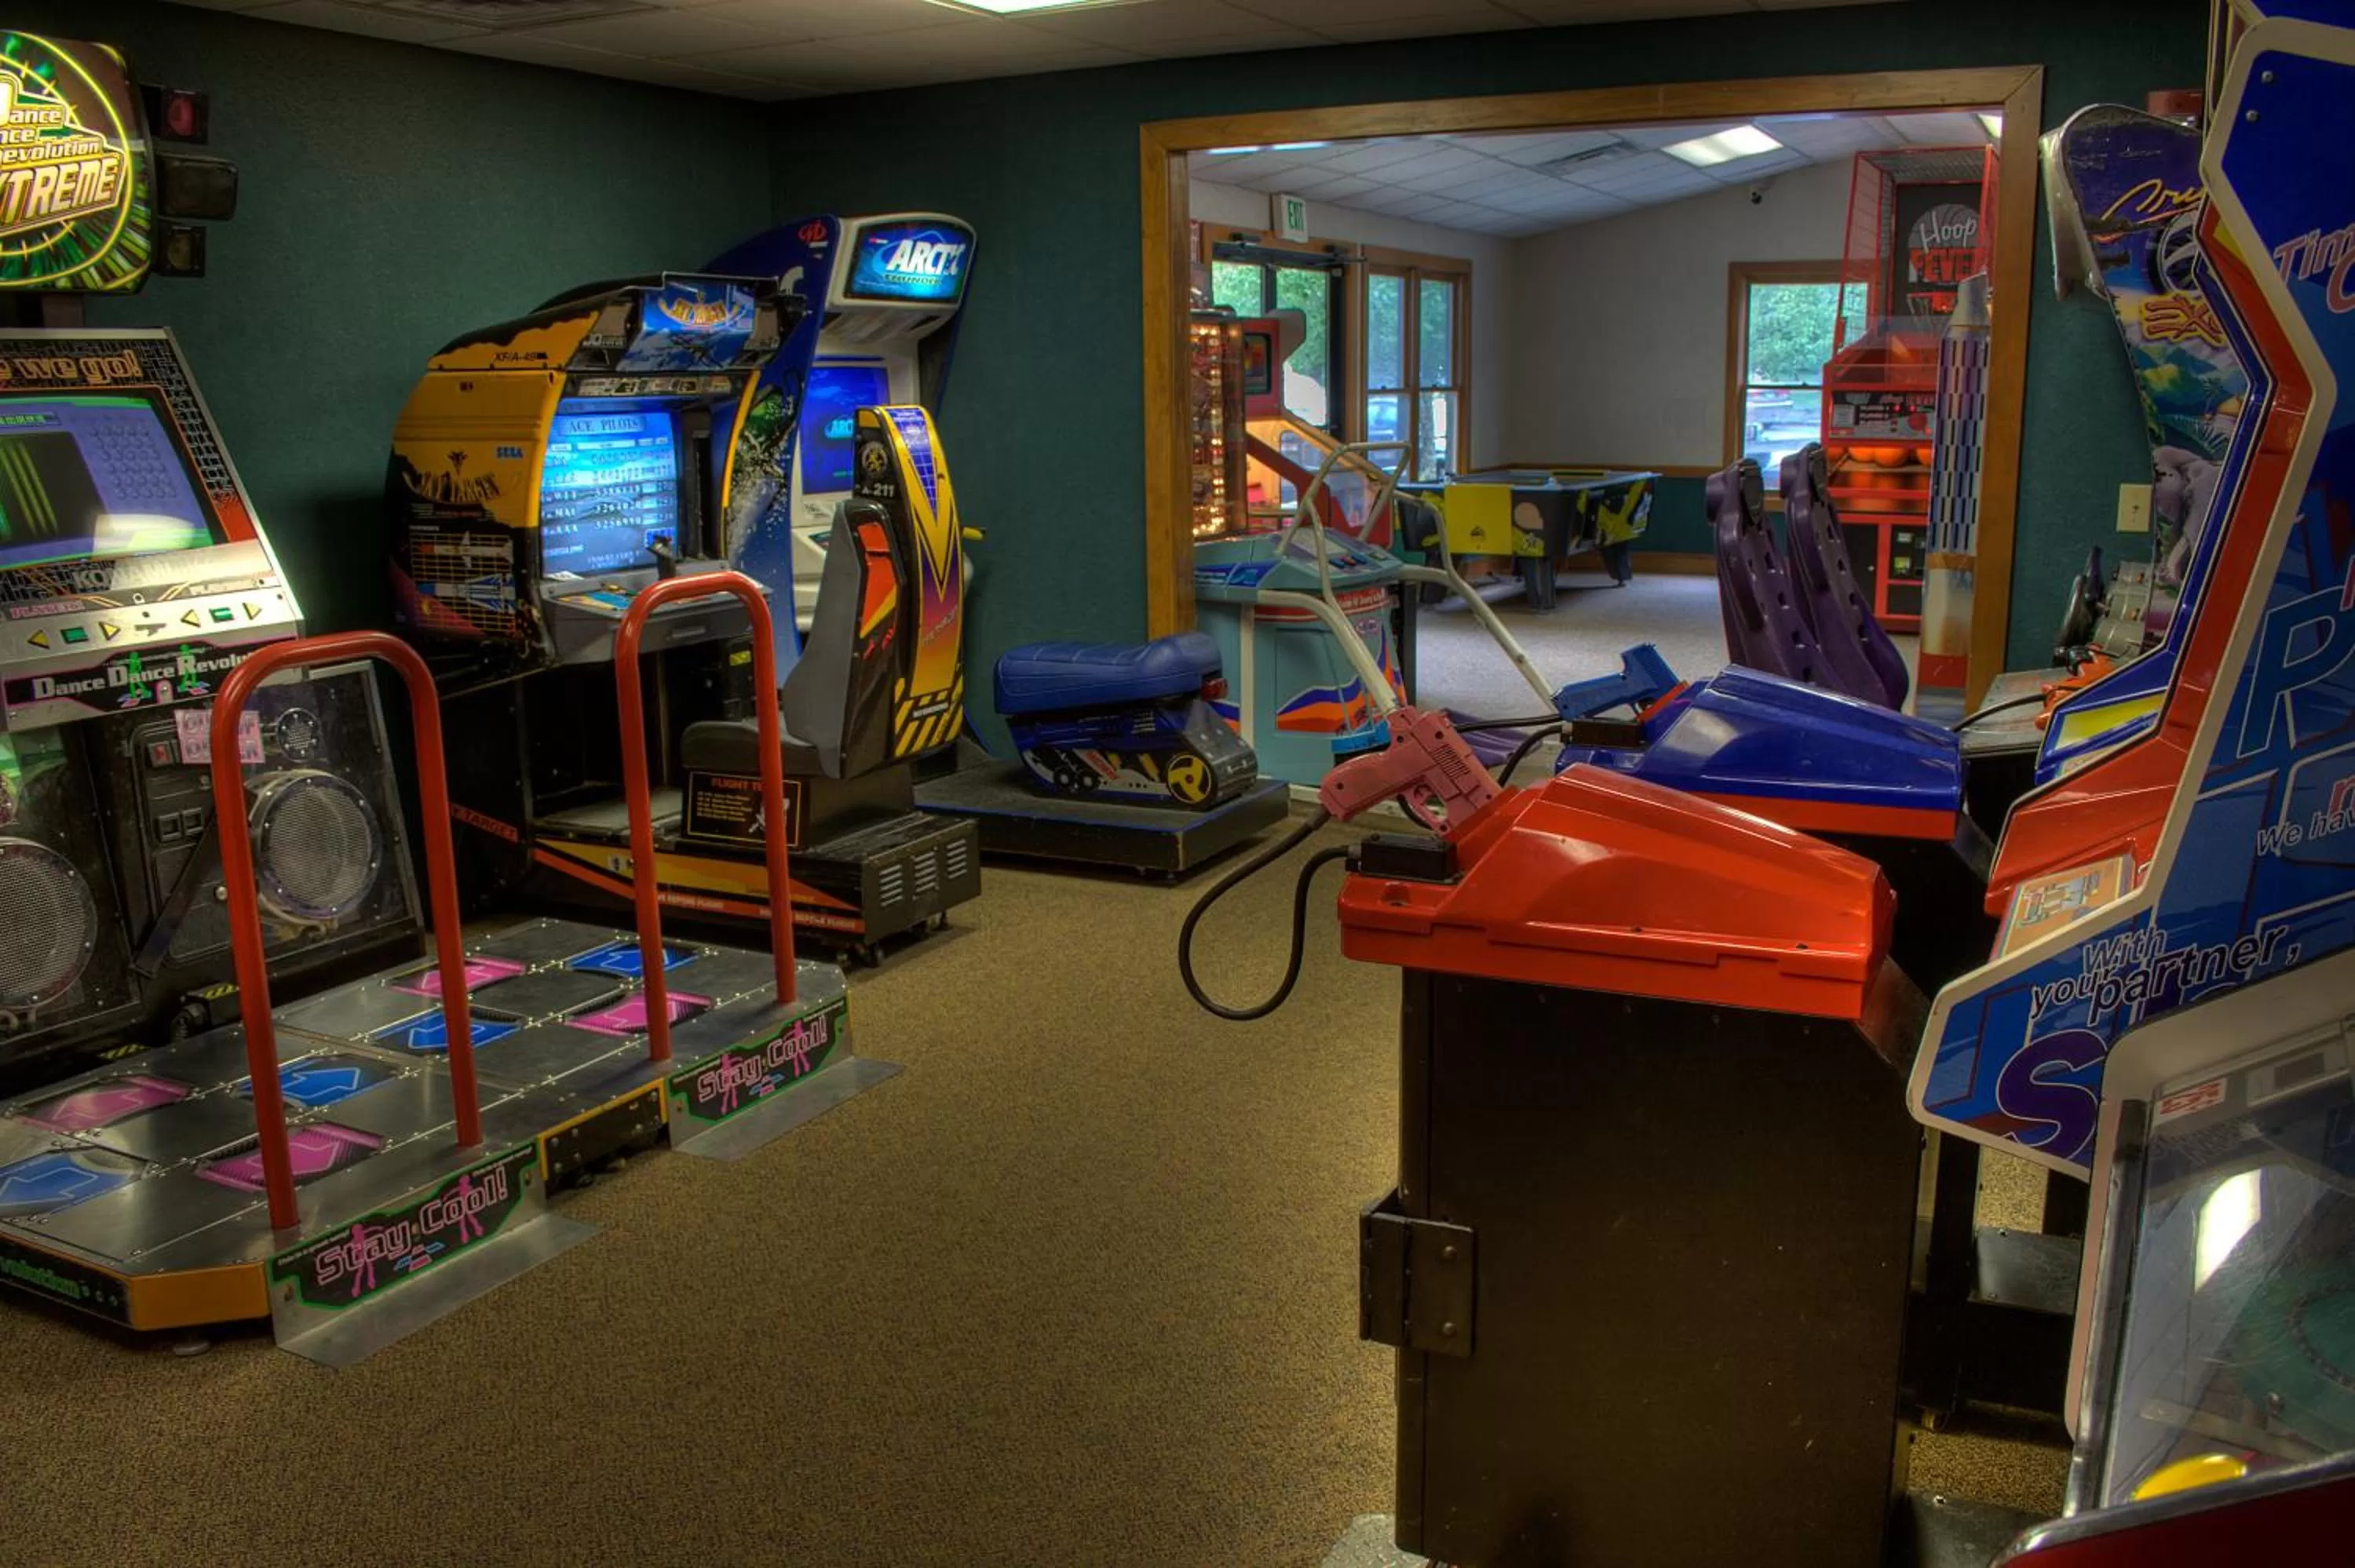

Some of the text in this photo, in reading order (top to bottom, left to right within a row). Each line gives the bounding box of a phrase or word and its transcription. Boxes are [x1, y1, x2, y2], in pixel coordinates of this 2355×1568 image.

[0, 127, 35, 144] nce
[0, 140, 99, 163] evolution
[0, 158, 118, 224] TREME
[1287, 200, 1304, 230] EXIT
[1919, 210, 1977, 254] Hoop
[2273, 223, 2355, 284] Tim
[79, 349, 143, 385] go!
[569, 420, 593, 432] ACE
[495, 445, 524, 459] SEGA
[34, 676, 106, 698] Dance
[108, 665, 176, 686] Dance
[176, 652, 254, 676] Revolu
[2258, 807, 2355, 858] We hav
[2083, 928, 2167, 975] With
[2028, 924, 2302, 1026] your partner,
[697, 1055, 762, 1103] Stay
[766, 1015, 828, 1067] Cool!
[314, 1220, 411, 1286] Stay
[418, 1165, 509, 1235] Cool!
